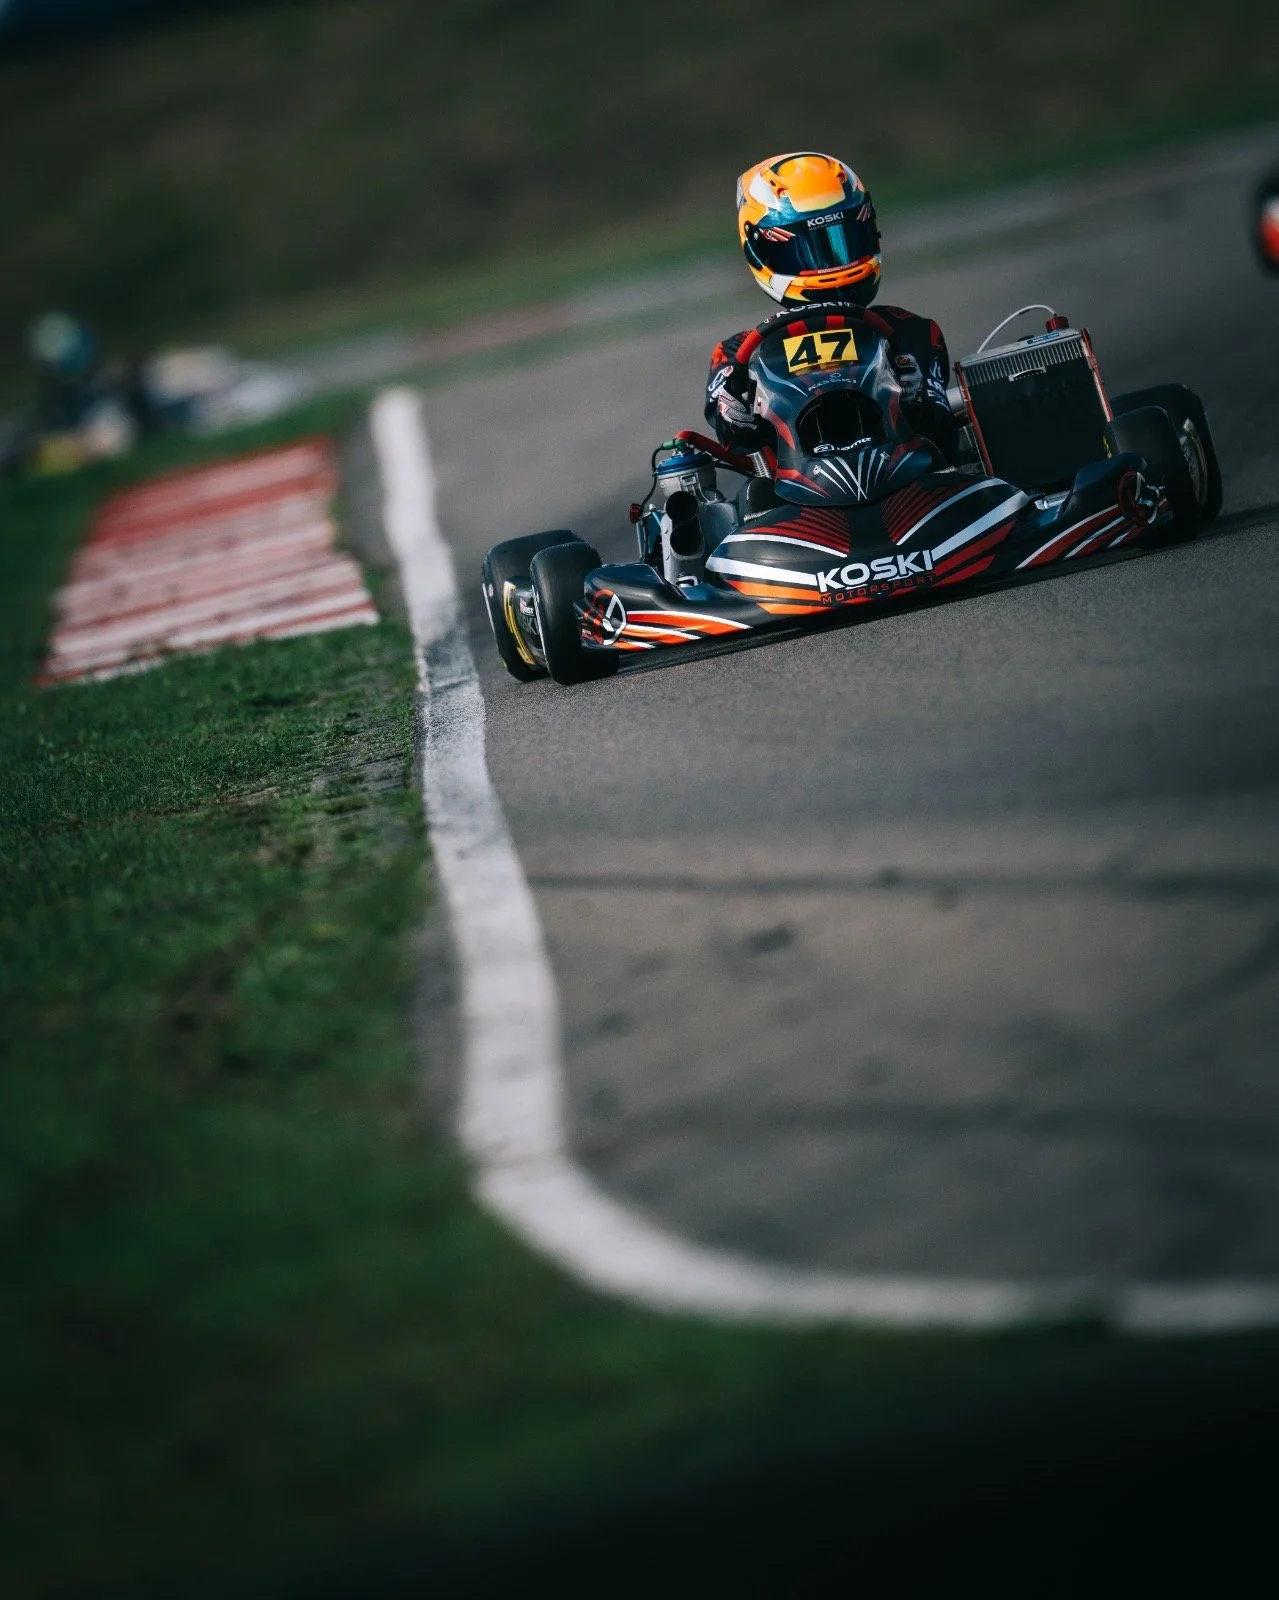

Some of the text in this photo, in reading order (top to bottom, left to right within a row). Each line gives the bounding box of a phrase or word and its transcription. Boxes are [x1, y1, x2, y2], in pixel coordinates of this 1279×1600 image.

[806, 211, 845, 228] KOSKI
[789, 331, 852, 368] 47
[816, 549, 934, 593] KOSKI
[821, 574, 936, 605] MOTORSPORT
